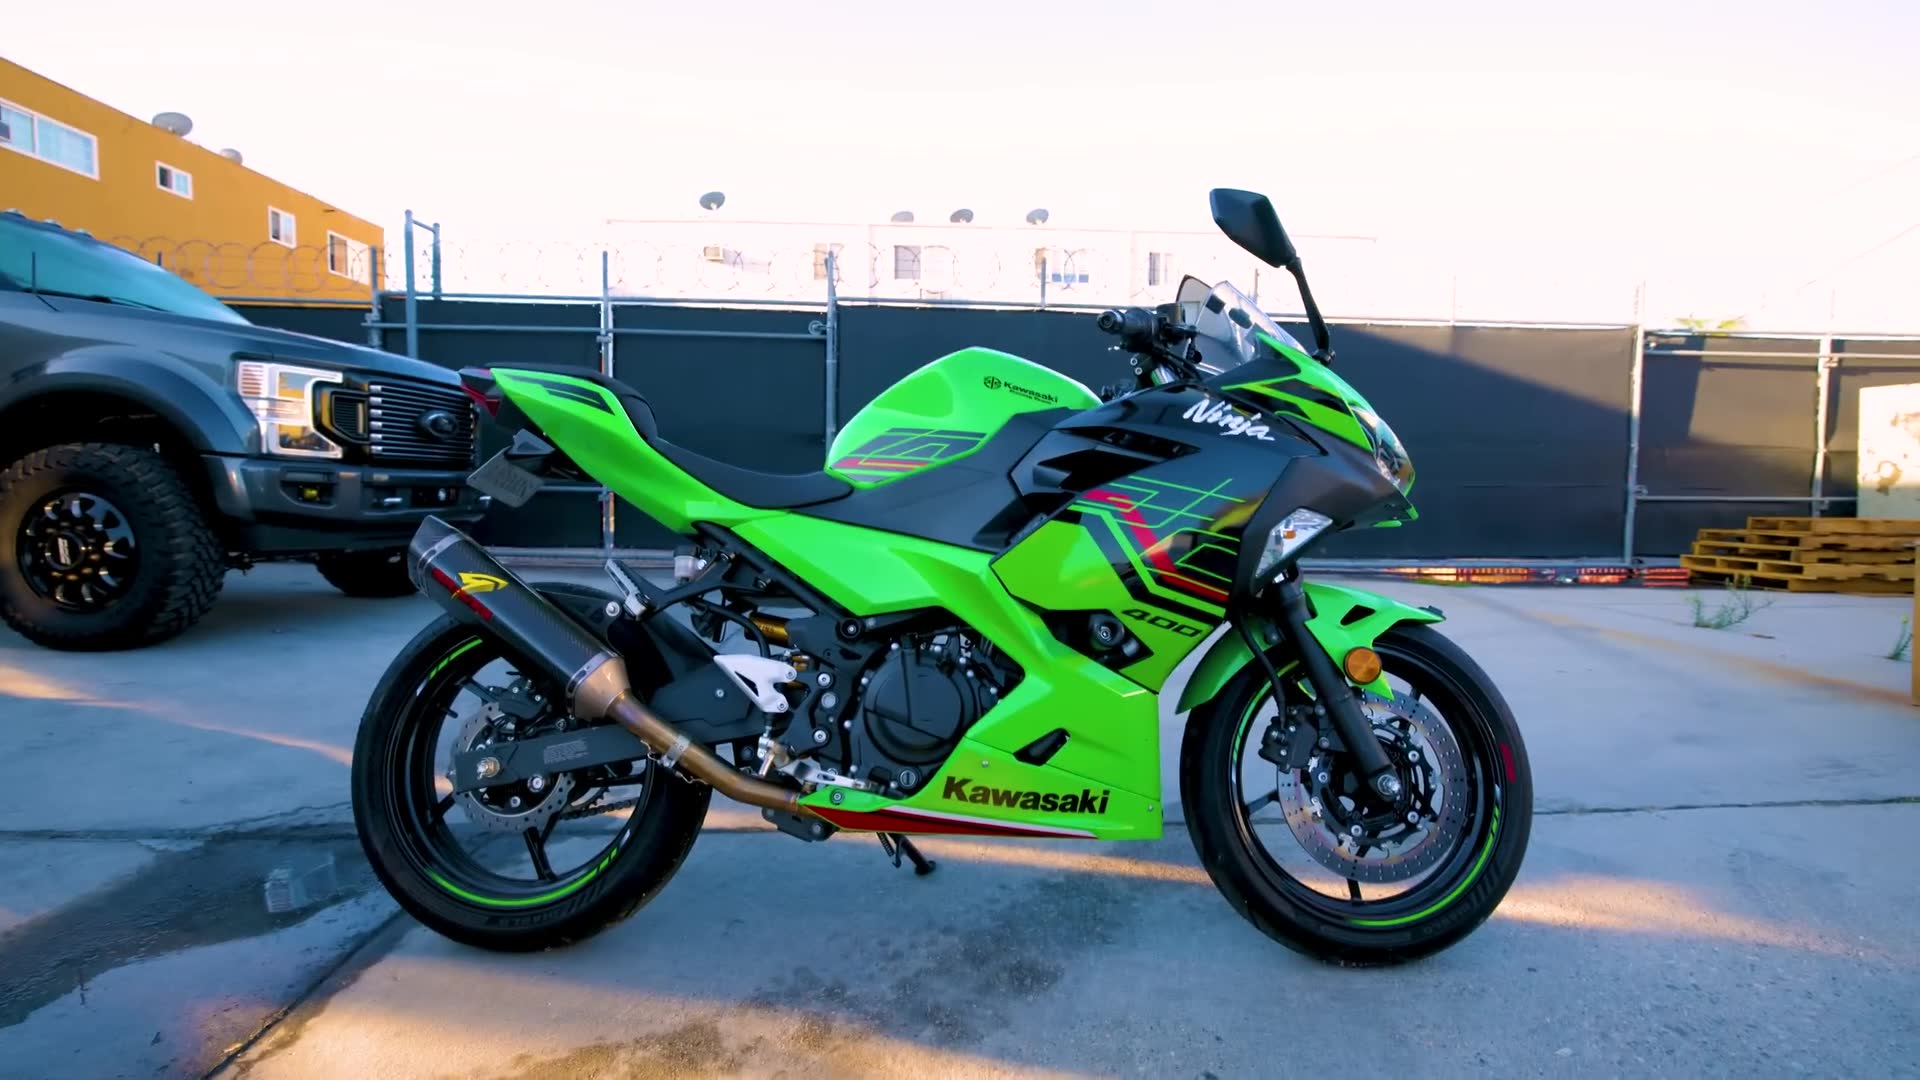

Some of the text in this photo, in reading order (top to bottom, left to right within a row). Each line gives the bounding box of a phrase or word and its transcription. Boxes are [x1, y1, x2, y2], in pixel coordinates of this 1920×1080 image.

[1004, 381, 1058, 403] Kawasaki
[1182, 398, 1276, 441] Ninja
[1121, 609, 1203, 638] 400
[942, 775, 1110, 815] Kawasaki
